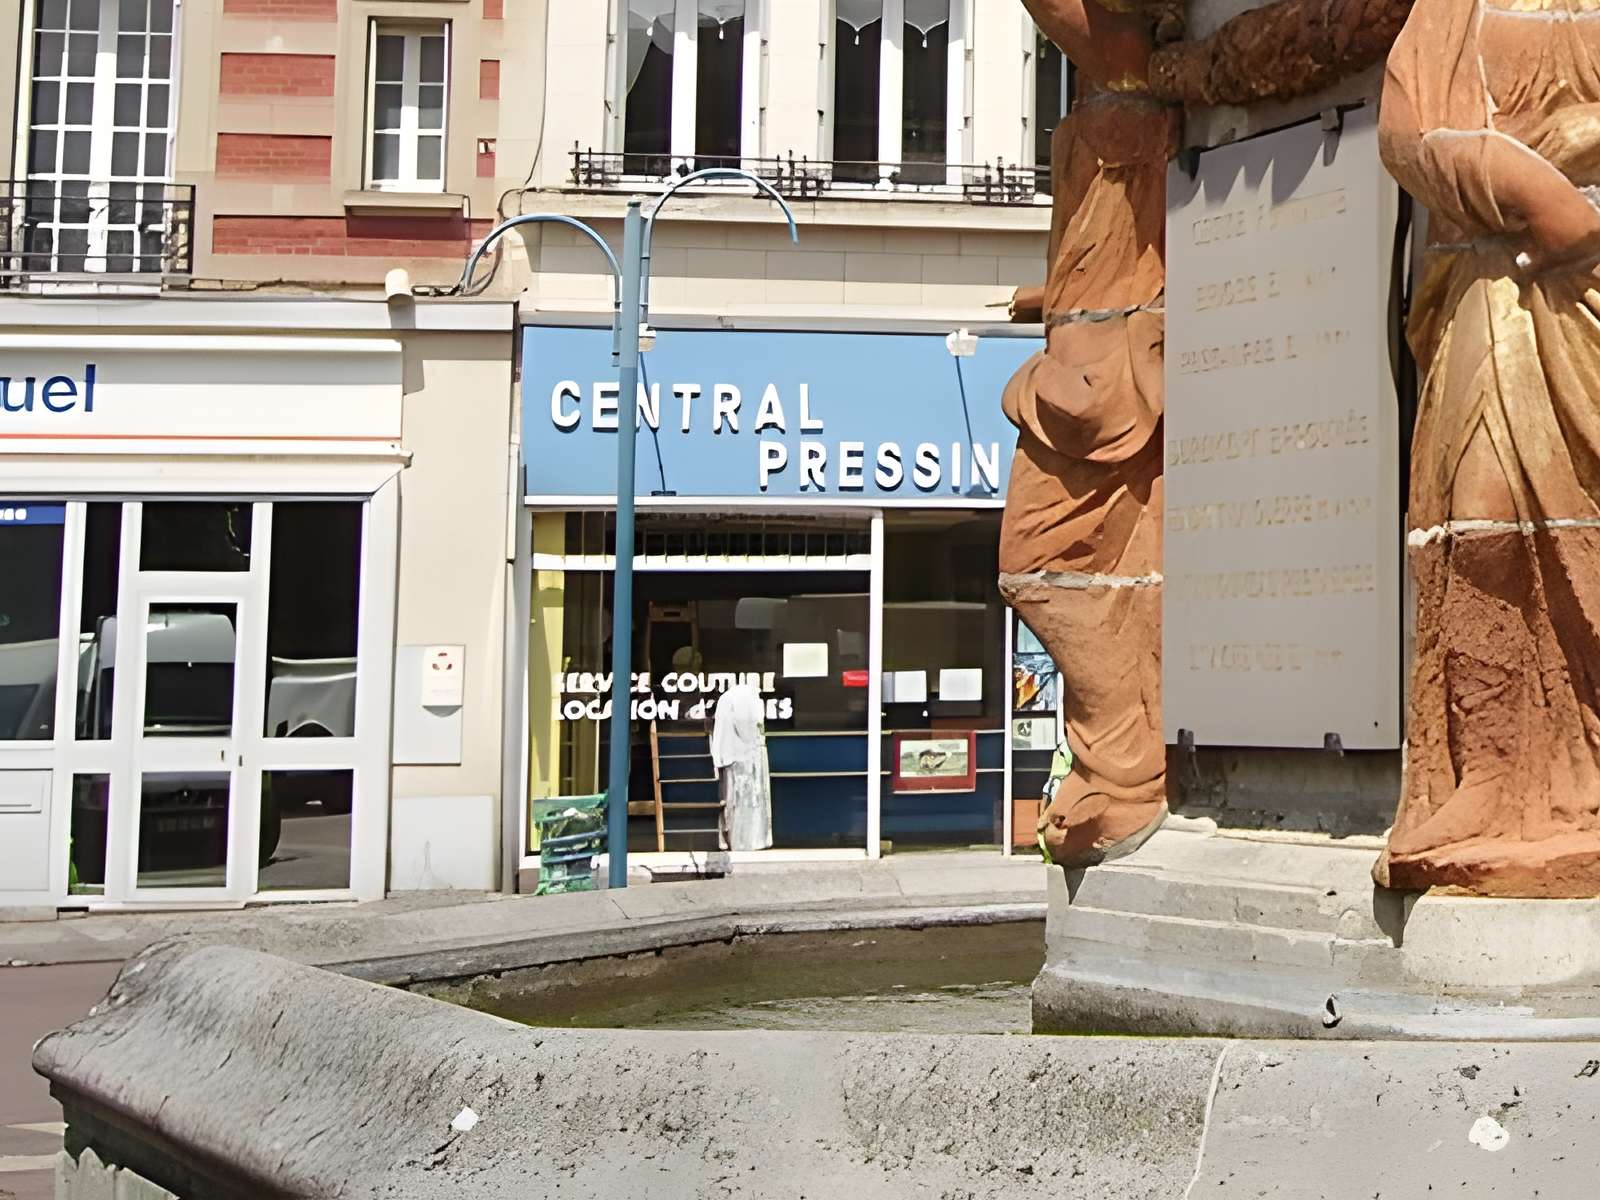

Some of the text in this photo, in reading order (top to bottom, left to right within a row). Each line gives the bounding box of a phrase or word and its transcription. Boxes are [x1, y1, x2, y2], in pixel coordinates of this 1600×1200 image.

[0, 364, 96, 412] uel
[550, 380, 824, 433] CENTRAL
[759, 441, 1000, 490] PRESSIN
